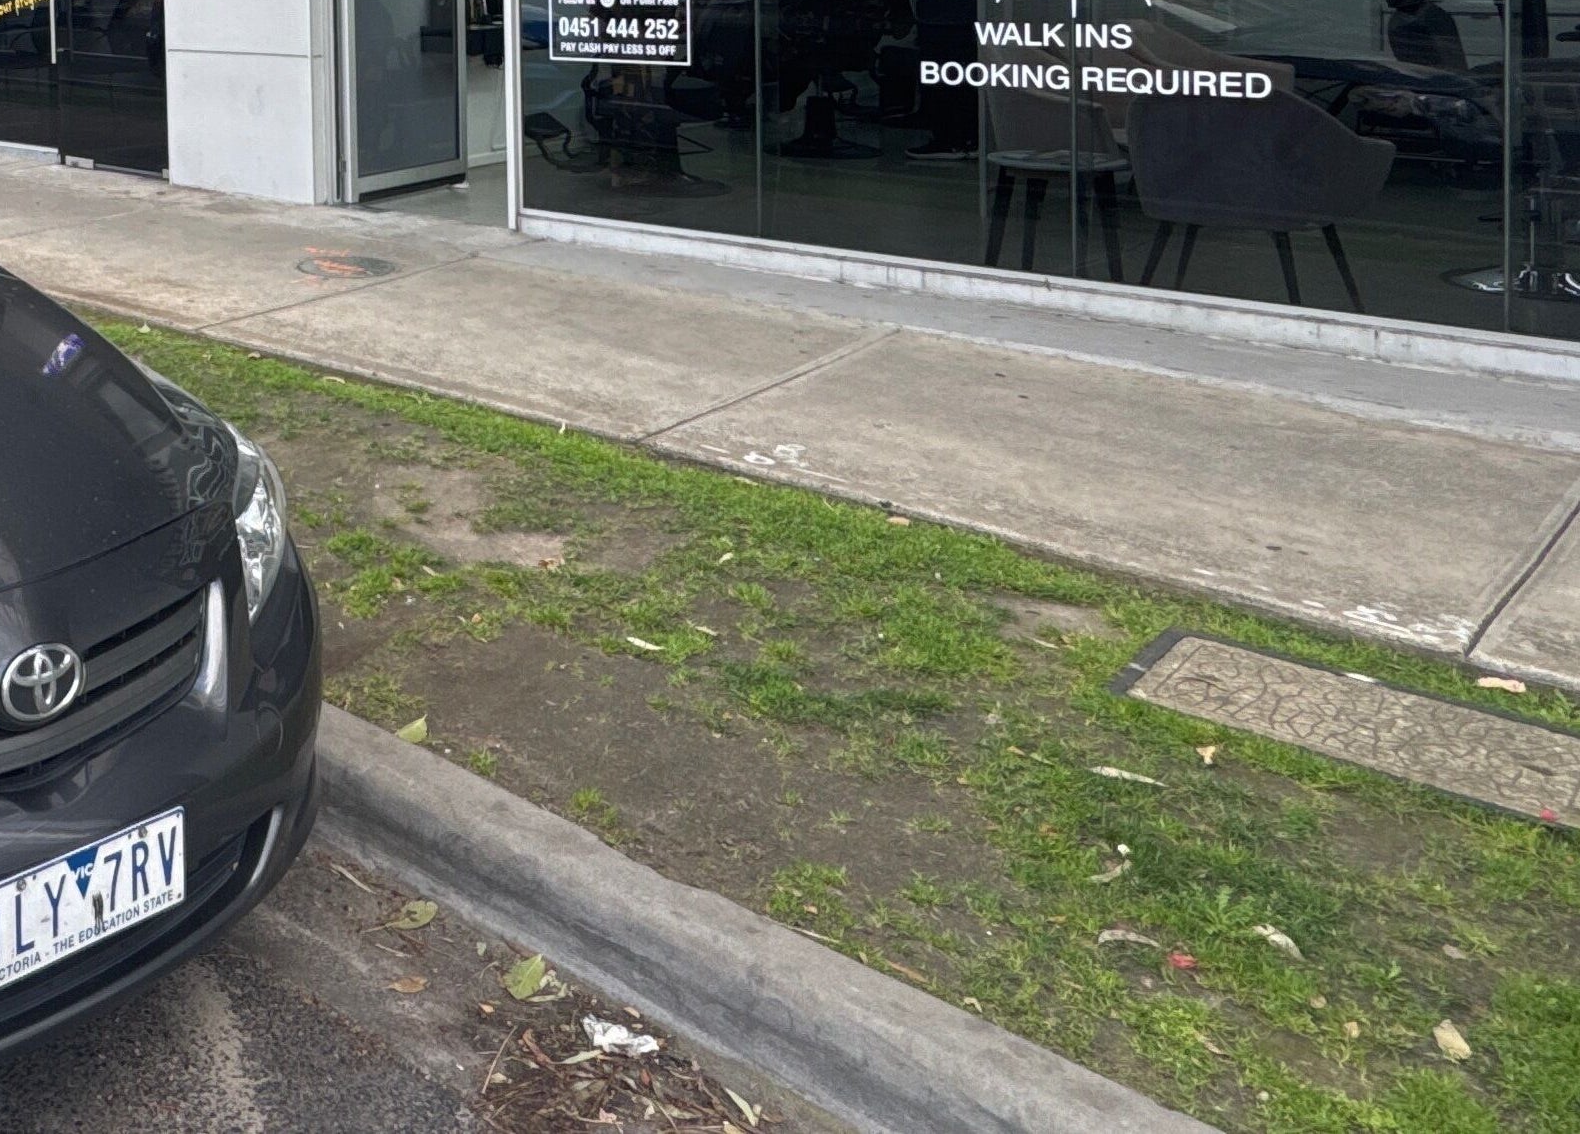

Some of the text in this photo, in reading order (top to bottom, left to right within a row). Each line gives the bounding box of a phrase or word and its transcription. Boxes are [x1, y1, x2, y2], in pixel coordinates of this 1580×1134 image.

[558, 16, 679, 40] 0451 444 252
[974, 21, 1133, 50] WALK INS
[560, 41, 576, 52] PAY
[578, 42, 601, 53] CASH
[602, 43, 620, 53] PAY
[621, 44, 644, 55] LESS
[658, 45, 677, 56] OFF
[920, 60, 1272, 99] BOOKING REQUIRED
[71, 863, 94, 879] VIC
[104, 826, 178, 912] 7RV
[52, 936, 75, 955] THE
[78, 907, 141, 942] EDUCATION
[142, 890, 175, 914] STATE
